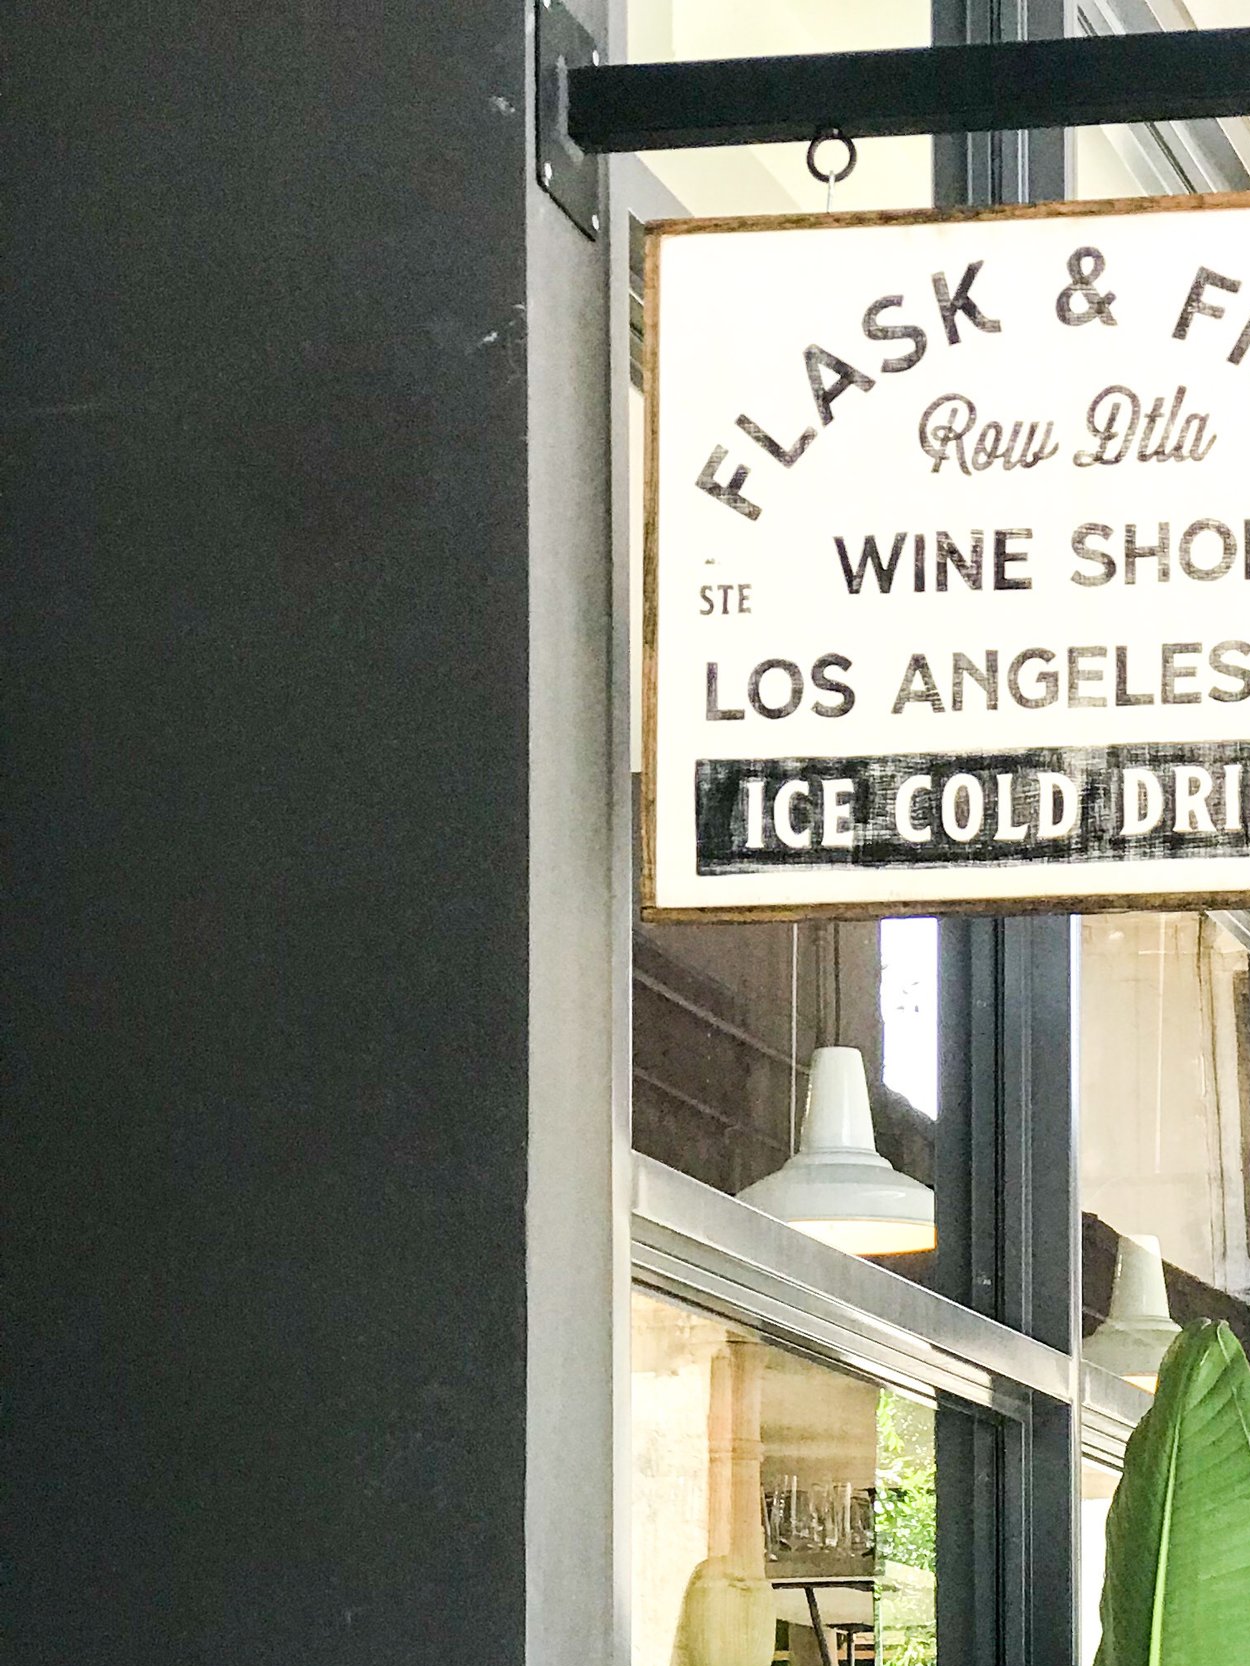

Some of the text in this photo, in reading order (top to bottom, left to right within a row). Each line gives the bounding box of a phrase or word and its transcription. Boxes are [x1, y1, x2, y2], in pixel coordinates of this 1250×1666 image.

[695, 259, 1002, 522] FLASK
[1055, 246, 1118, 327] &
[917, 384, 1217, 476] Row Dtla
[833, 528, 1034, 595] WINE
[699, 584, 752, 616] STE
[705, 651, 857, 722] LOS
[745, 778, 856, 850] ICE
[894, 770, 1081, 846] COLD
